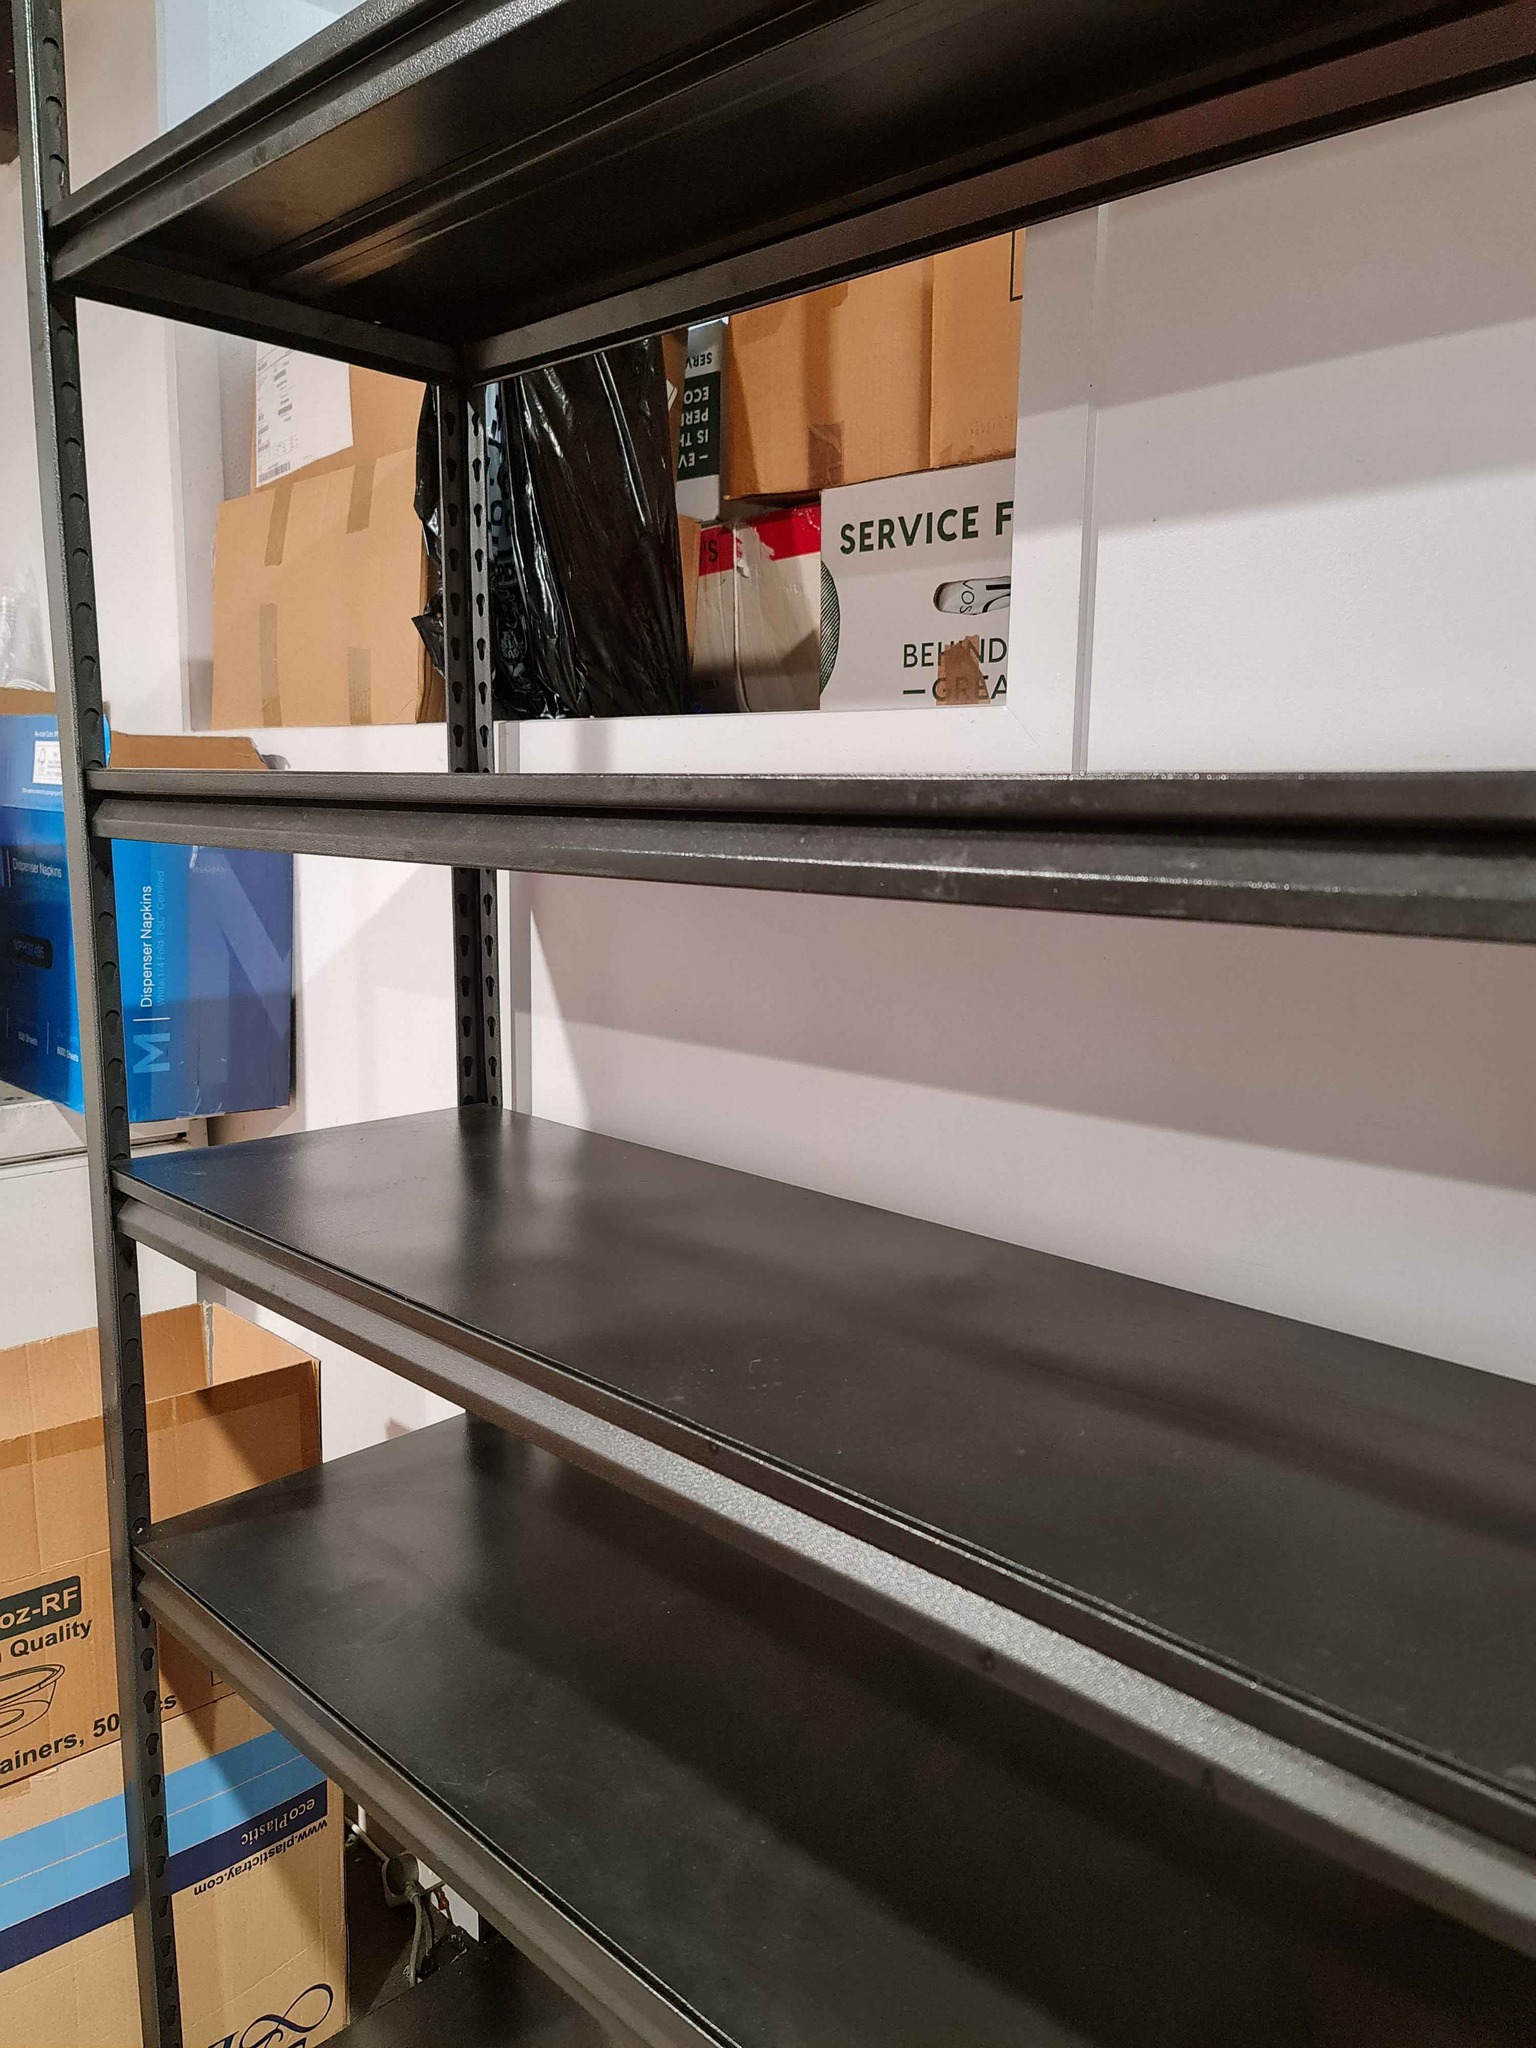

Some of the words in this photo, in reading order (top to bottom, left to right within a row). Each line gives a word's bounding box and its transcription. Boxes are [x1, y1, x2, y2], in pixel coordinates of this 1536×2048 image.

[684, 386, 710, 405] ECO
[697, 428, 709, 444] IS
[840, 506, 979, 555] SERVICE
[12, 857, 39, 875] Dispenser
[39, 862, 63, 879] Napkins
[140, 885, 155, 939] Napkins
[140, 942, 155, 1008] Dispenser
[132, 1033, 171, 1074] M
[10, 1619, 93, 1657] Quality
[241, 1798, 315, 1846] ecoPlastic
[193, 1819, 328, 1896] www.plastictray.com
